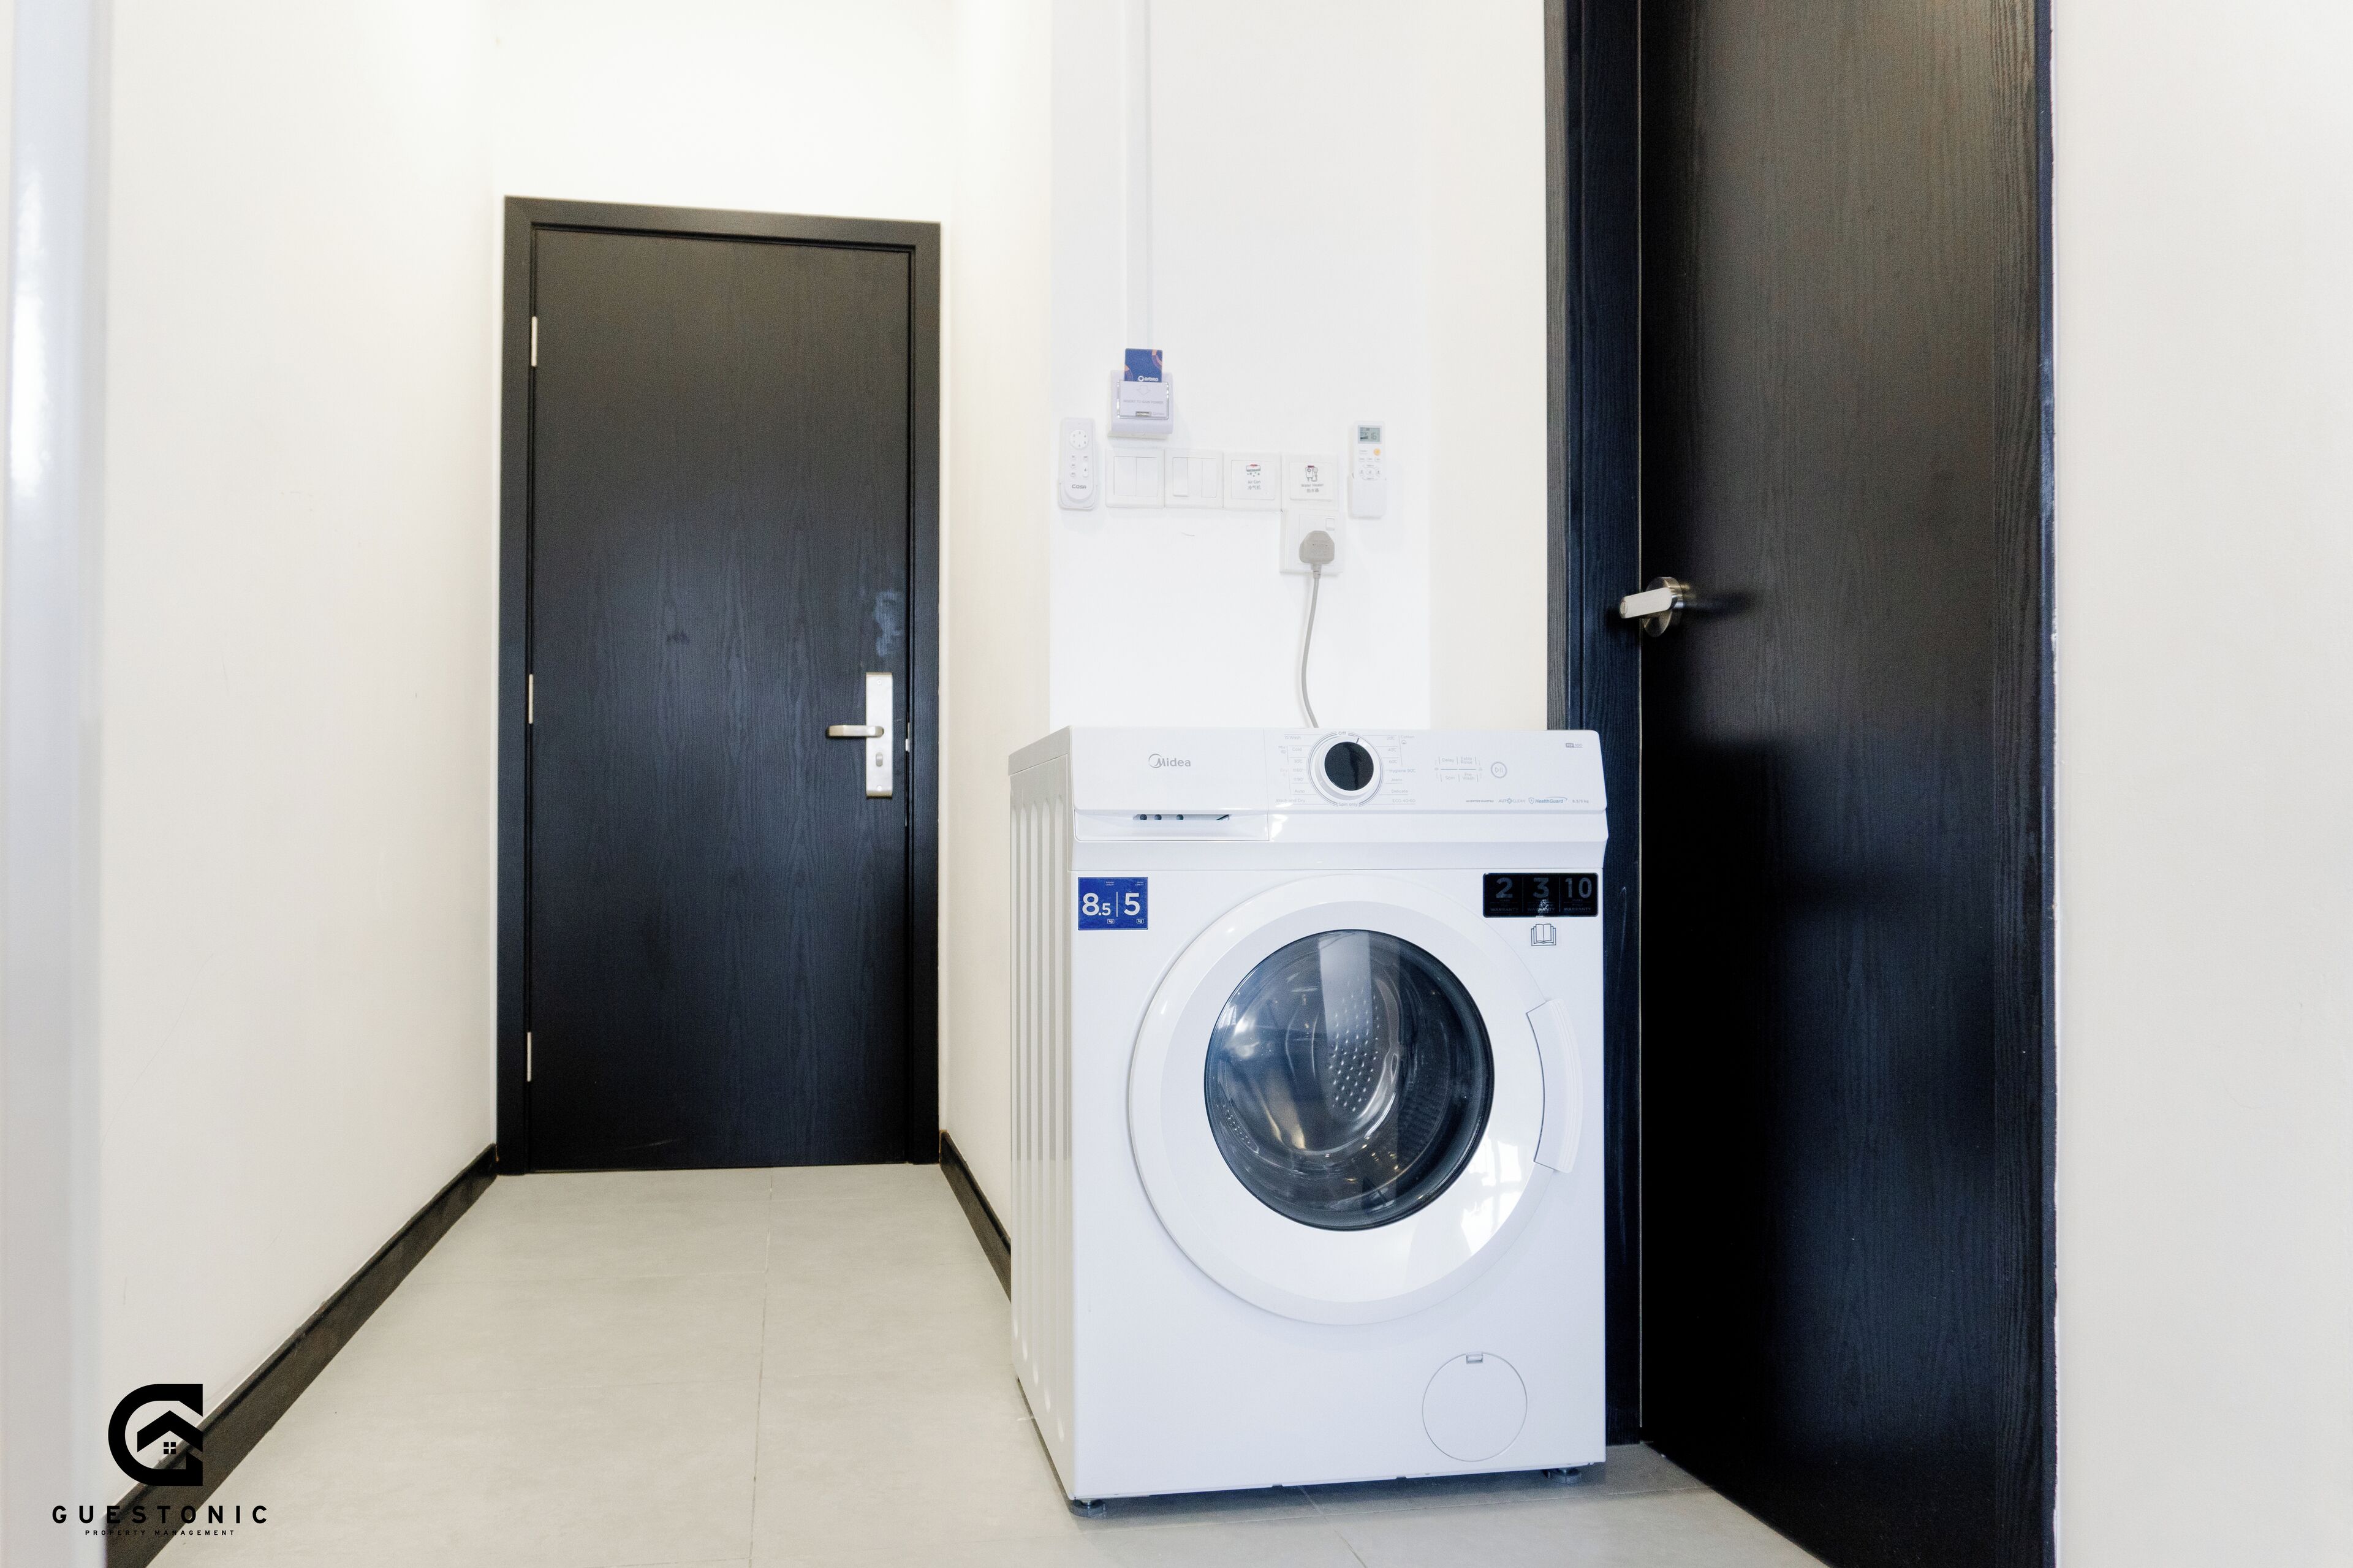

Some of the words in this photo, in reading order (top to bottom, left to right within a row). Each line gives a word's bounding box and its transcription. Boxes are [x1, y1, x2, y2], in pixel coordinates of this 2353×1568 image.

[1148, 753, 1191, 768] Midea
[1496, 877, 1514, 898] 2
[1533, 877, 1550, 898] 3
[1565, 877, 1592, 898] 10
[1082, 892, 1112, 916] 8.5
[1124, 893, 1140, 916] 5
